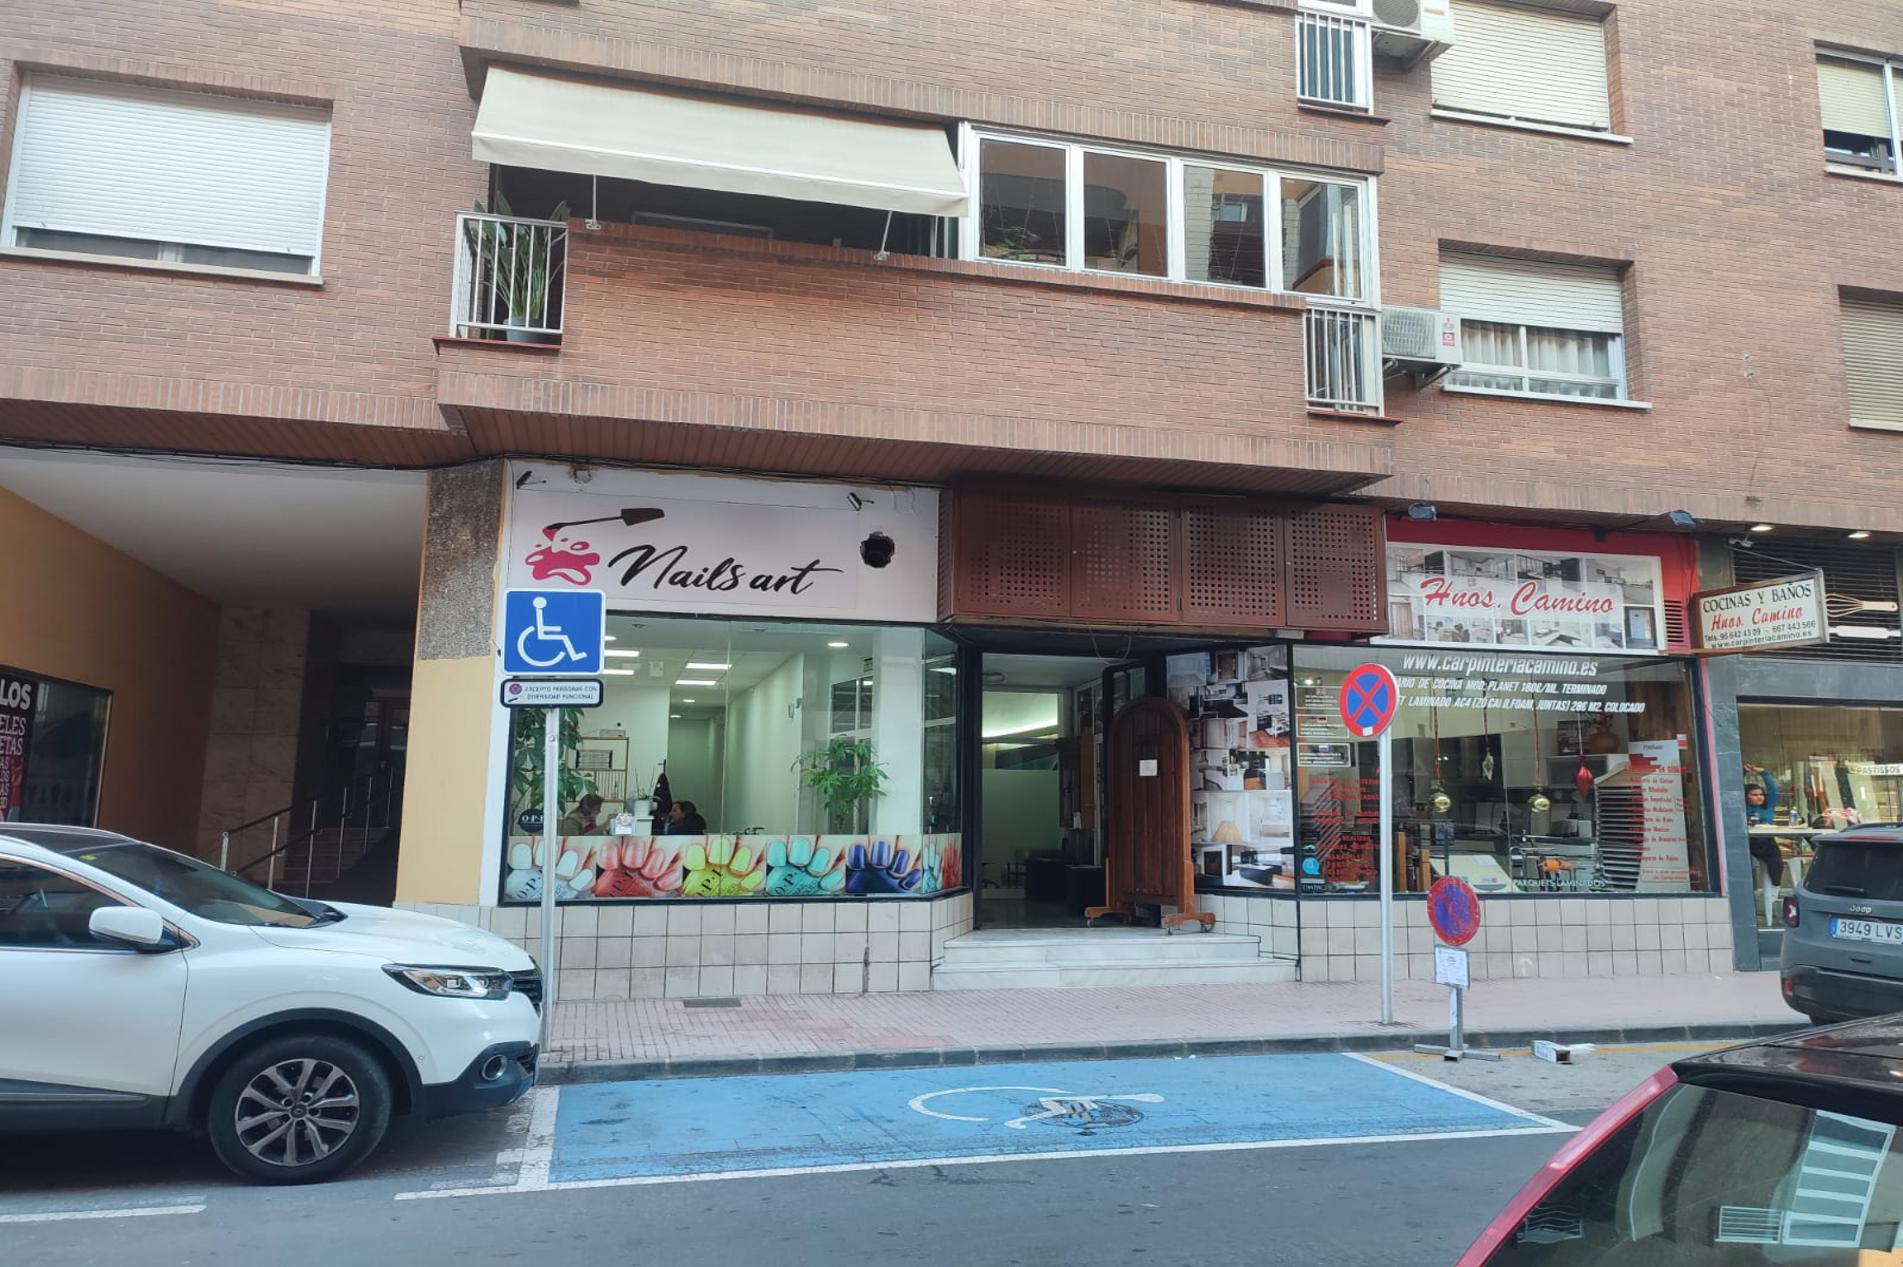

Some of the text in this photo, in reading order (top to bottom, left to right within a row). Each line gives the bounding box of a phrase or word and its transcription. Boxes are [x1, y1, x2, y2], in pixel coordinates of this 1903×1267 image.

[608, 544, 844, 595] Nails art
[1420, 577, 1614, 616] Hnos. Camino
[1703, 583, 1812, 613] COCINAS Y BAÑOS
[1752, 605, 1804, 625] Camino
[1711, 631, 1812, 648] www.carpinteriacamino.es
[1403, 655, 1598, 676] www.carpinteriacamino.es
[1418, 678, 1430, 689] DE
[1432, 678, 1463, 690] COCINA
[1487, 681, 1520, 693] PLANET
[1562, 683, 1607, 695] TERMINADO
[1408, 696, 1451, 706] LAMINADO
[1454, 697, 1471, 708] AC4
[1604, 702, 1645, 713] COLOCADO
[1840, 921, 1902, 940] 3949 LVS
